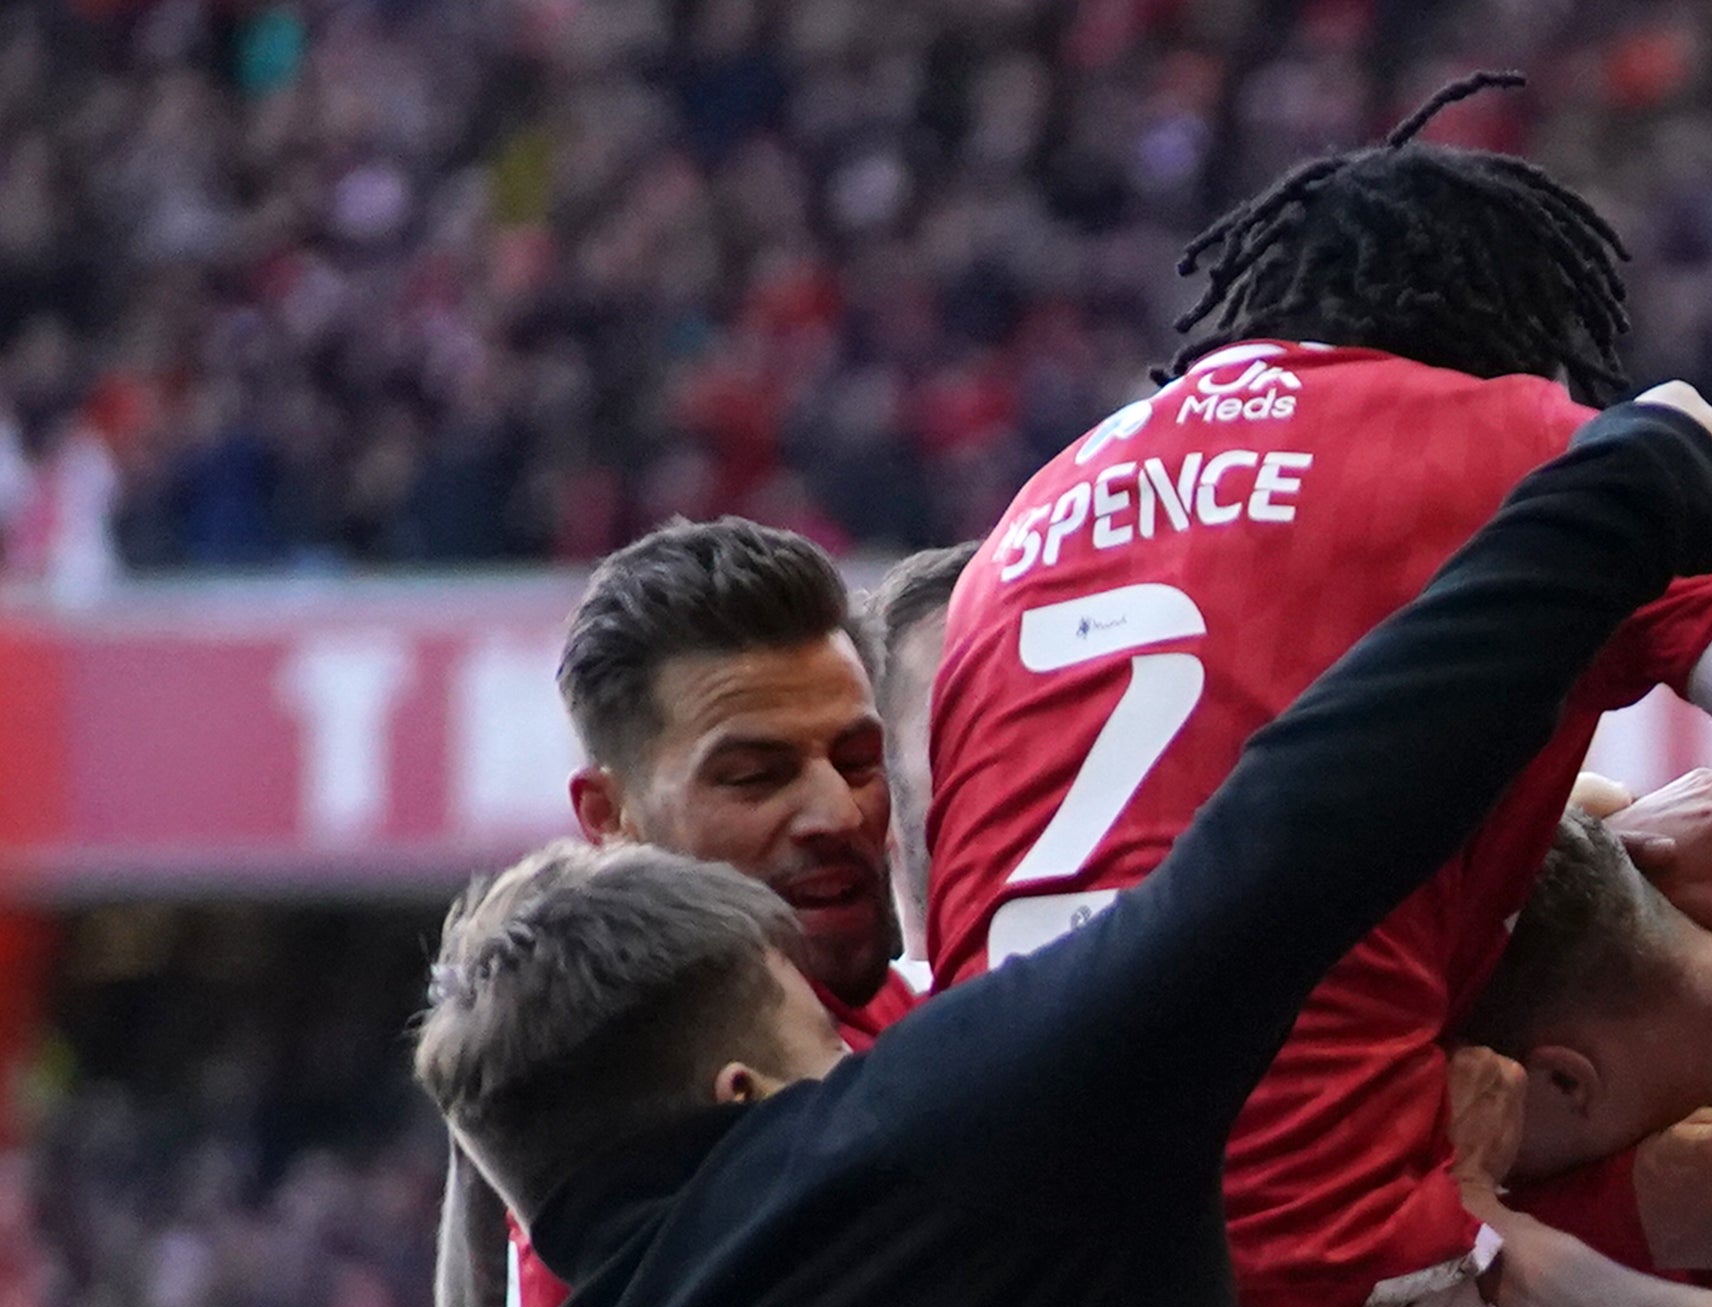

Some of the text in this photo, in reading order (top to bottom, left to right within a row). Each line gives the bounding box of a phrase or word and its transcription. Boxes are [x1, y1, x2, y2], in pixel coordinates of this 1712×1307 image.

[1175, 387, 1297, 425] Meds
[1000, 450, 1313, 583] SPENCE
[988, 582, 1207, 968] 2
